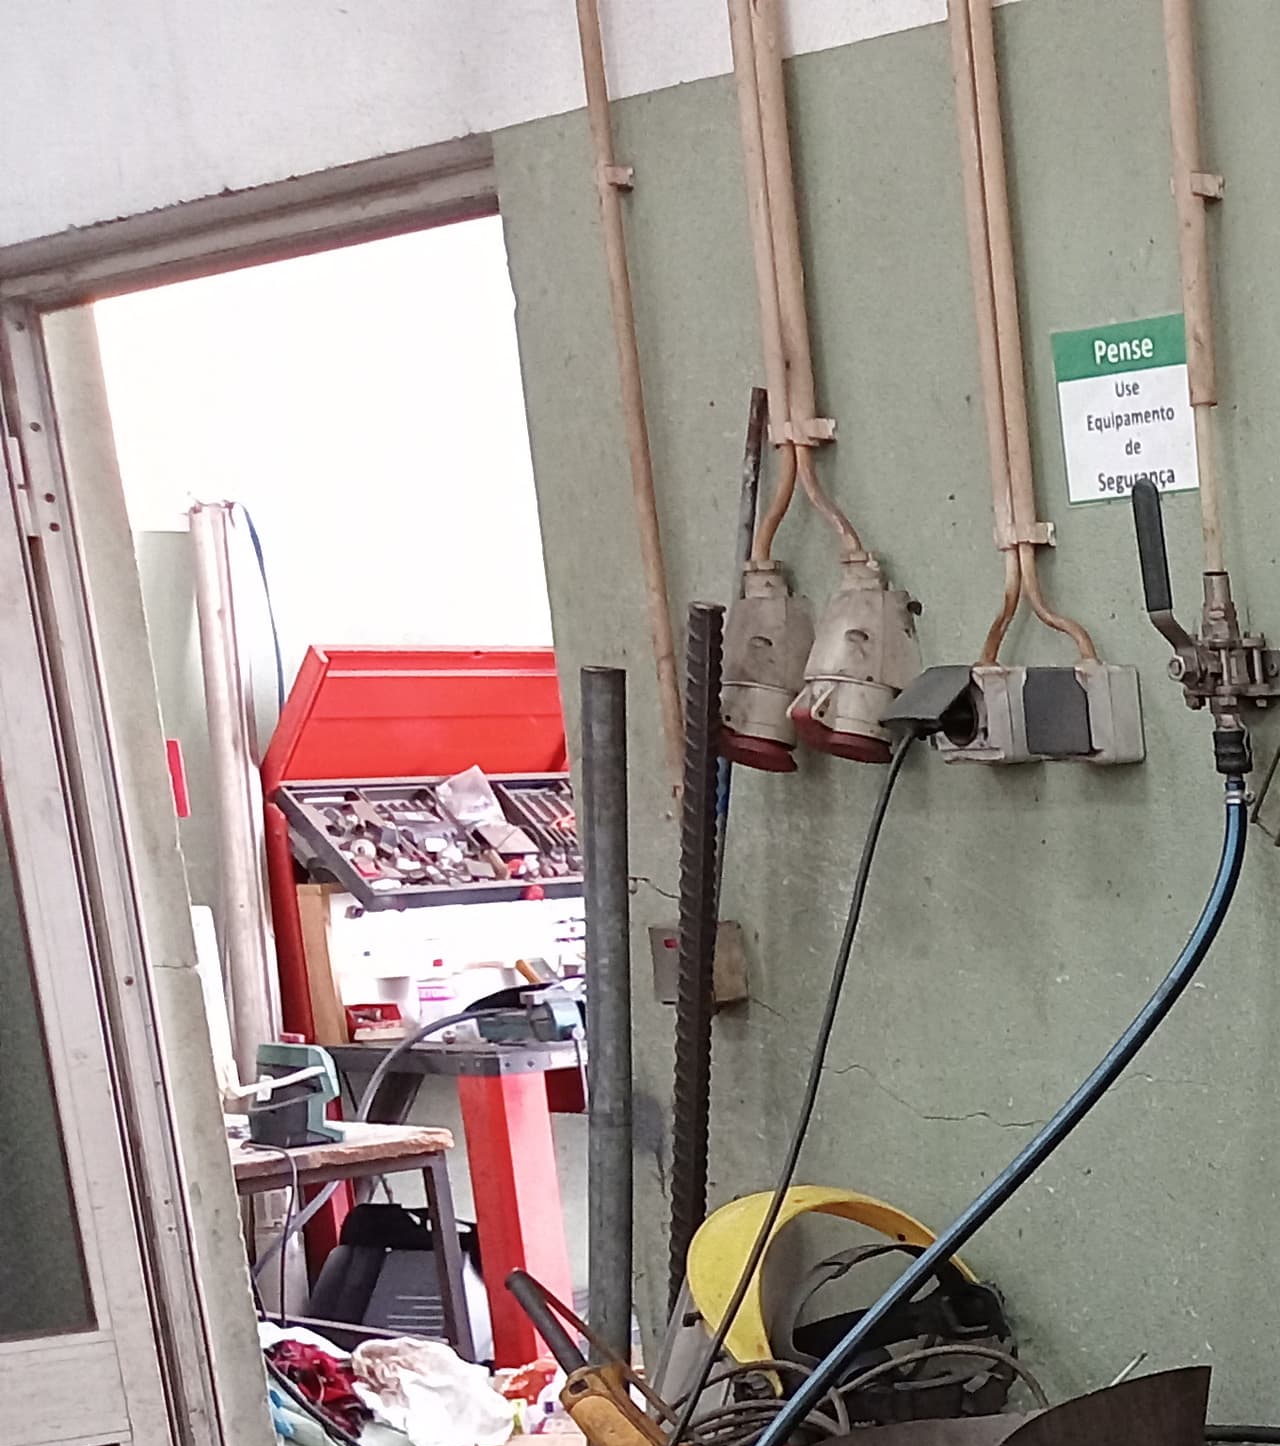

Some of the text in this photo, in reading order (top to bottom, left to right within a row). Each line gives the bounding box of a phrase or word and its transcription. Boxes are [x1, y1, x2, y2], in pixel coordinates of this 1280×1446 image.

[1094, 338, 1154, 365] Pense
[1115, 380, 1140, 398] Use
[1086, 407, 1175, 433] Equipamento
[1125, 438, 1142, 455] de
